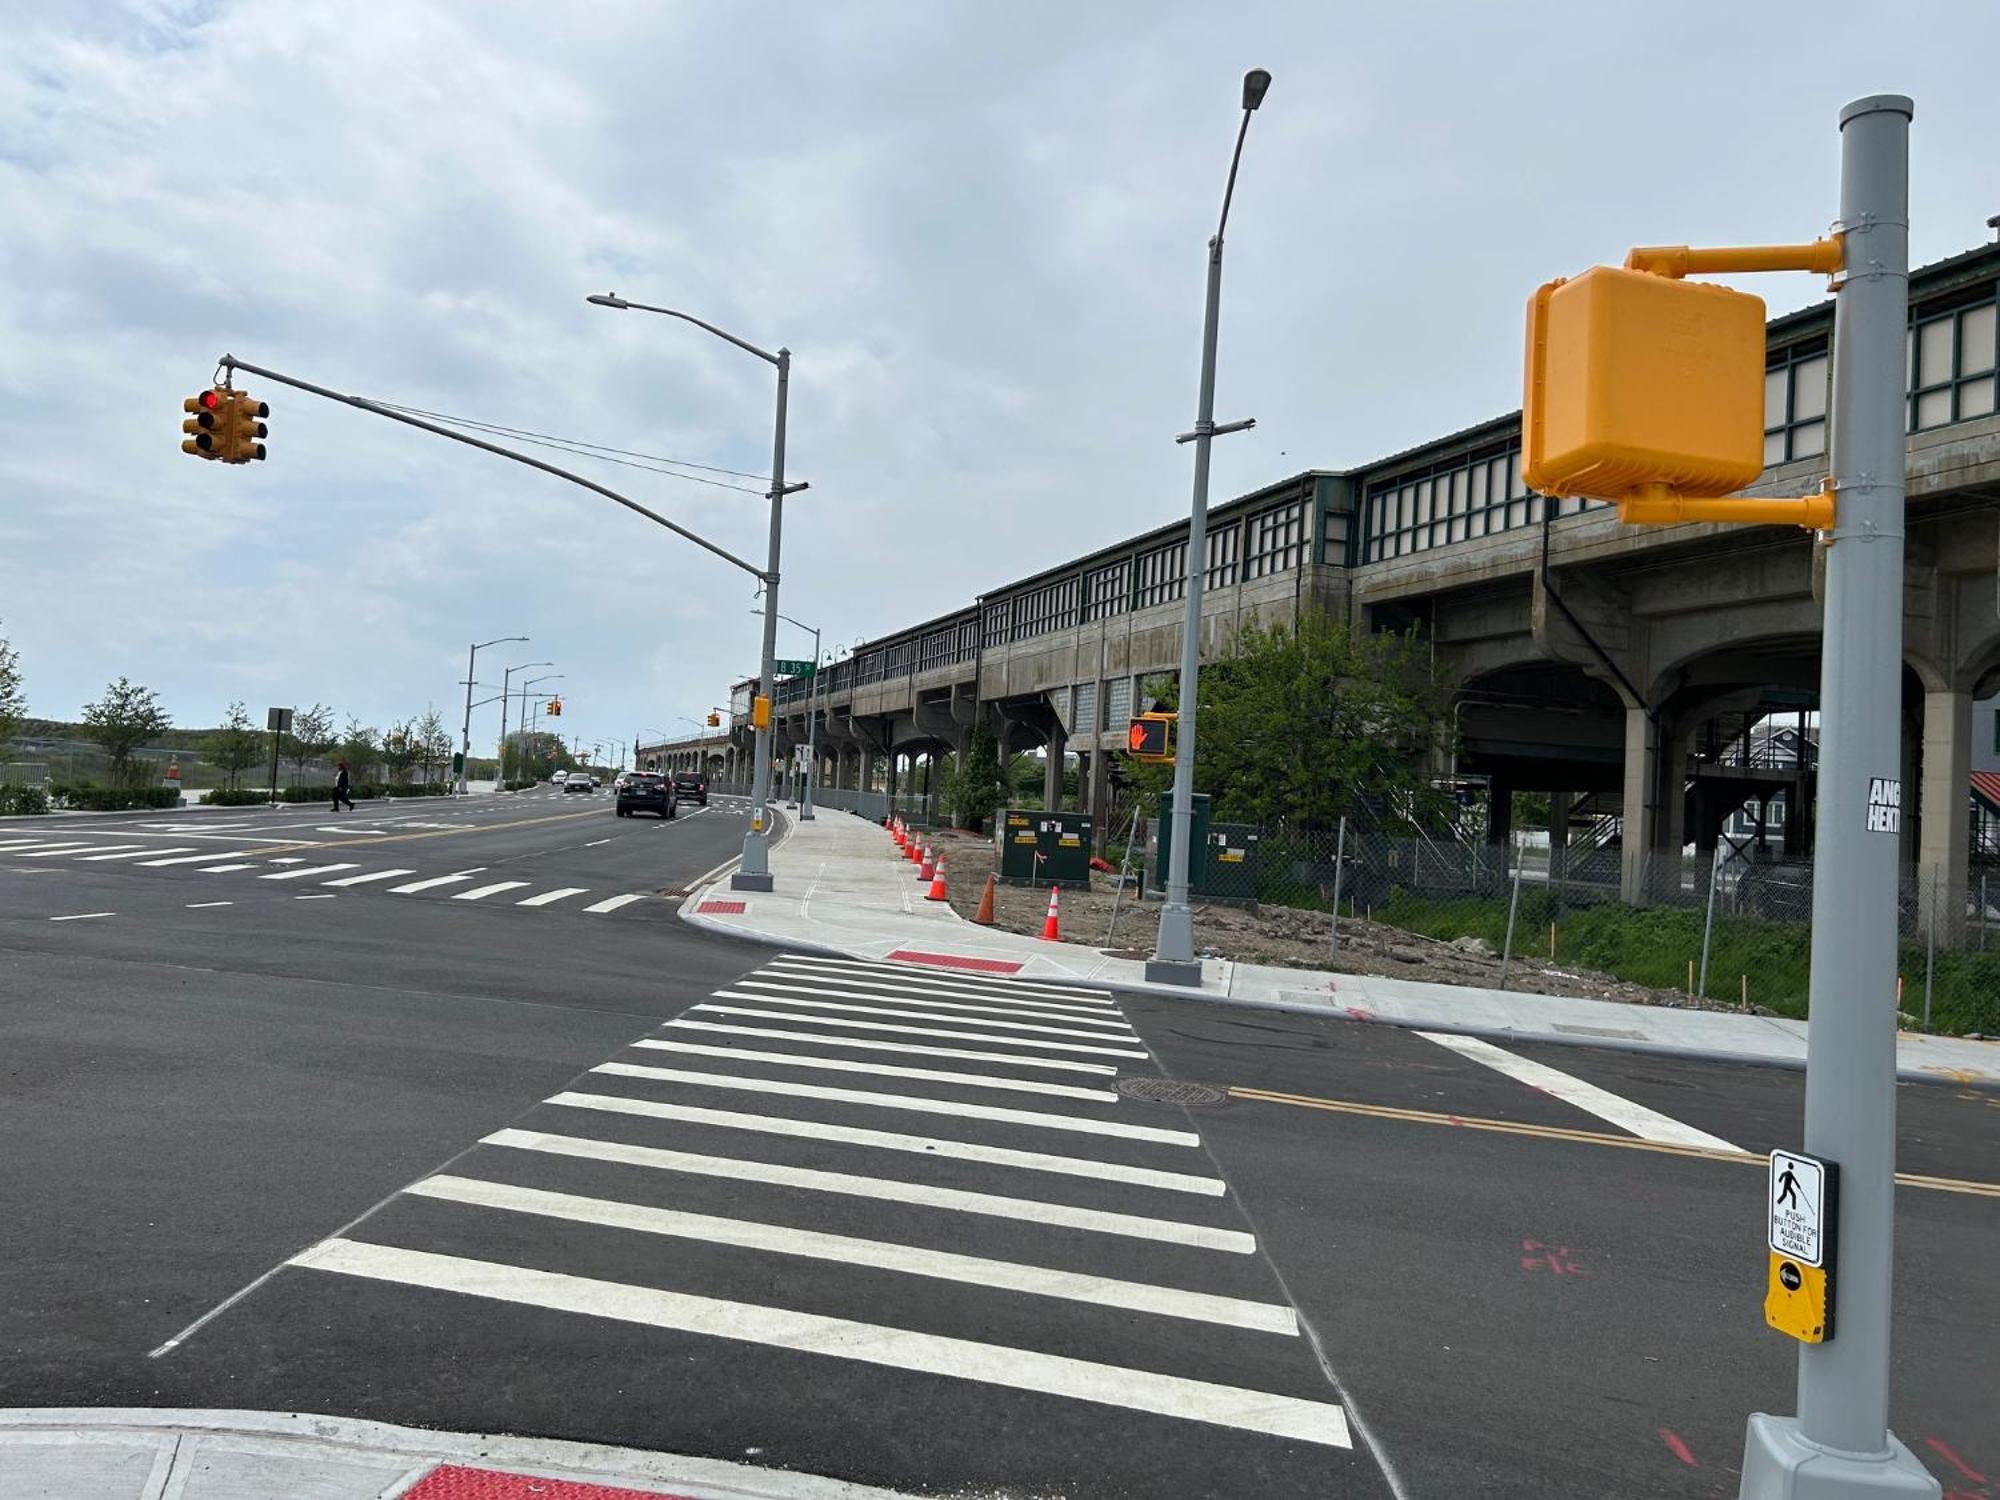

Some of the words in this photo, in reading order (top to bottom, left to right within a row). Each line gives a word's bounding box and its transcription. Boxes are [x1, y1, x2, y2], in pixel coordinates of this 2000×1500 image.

[1785, 1209, 1806, 1223] PUSH
[1774, 1215, 1801, 1232] BUTTON
[1803, 1225, 1817, 1239] FOR
[1781, 1227, 1811, 1246] AUDIBLE
[1782, 1237, 1809, 1255] SIGNAL
